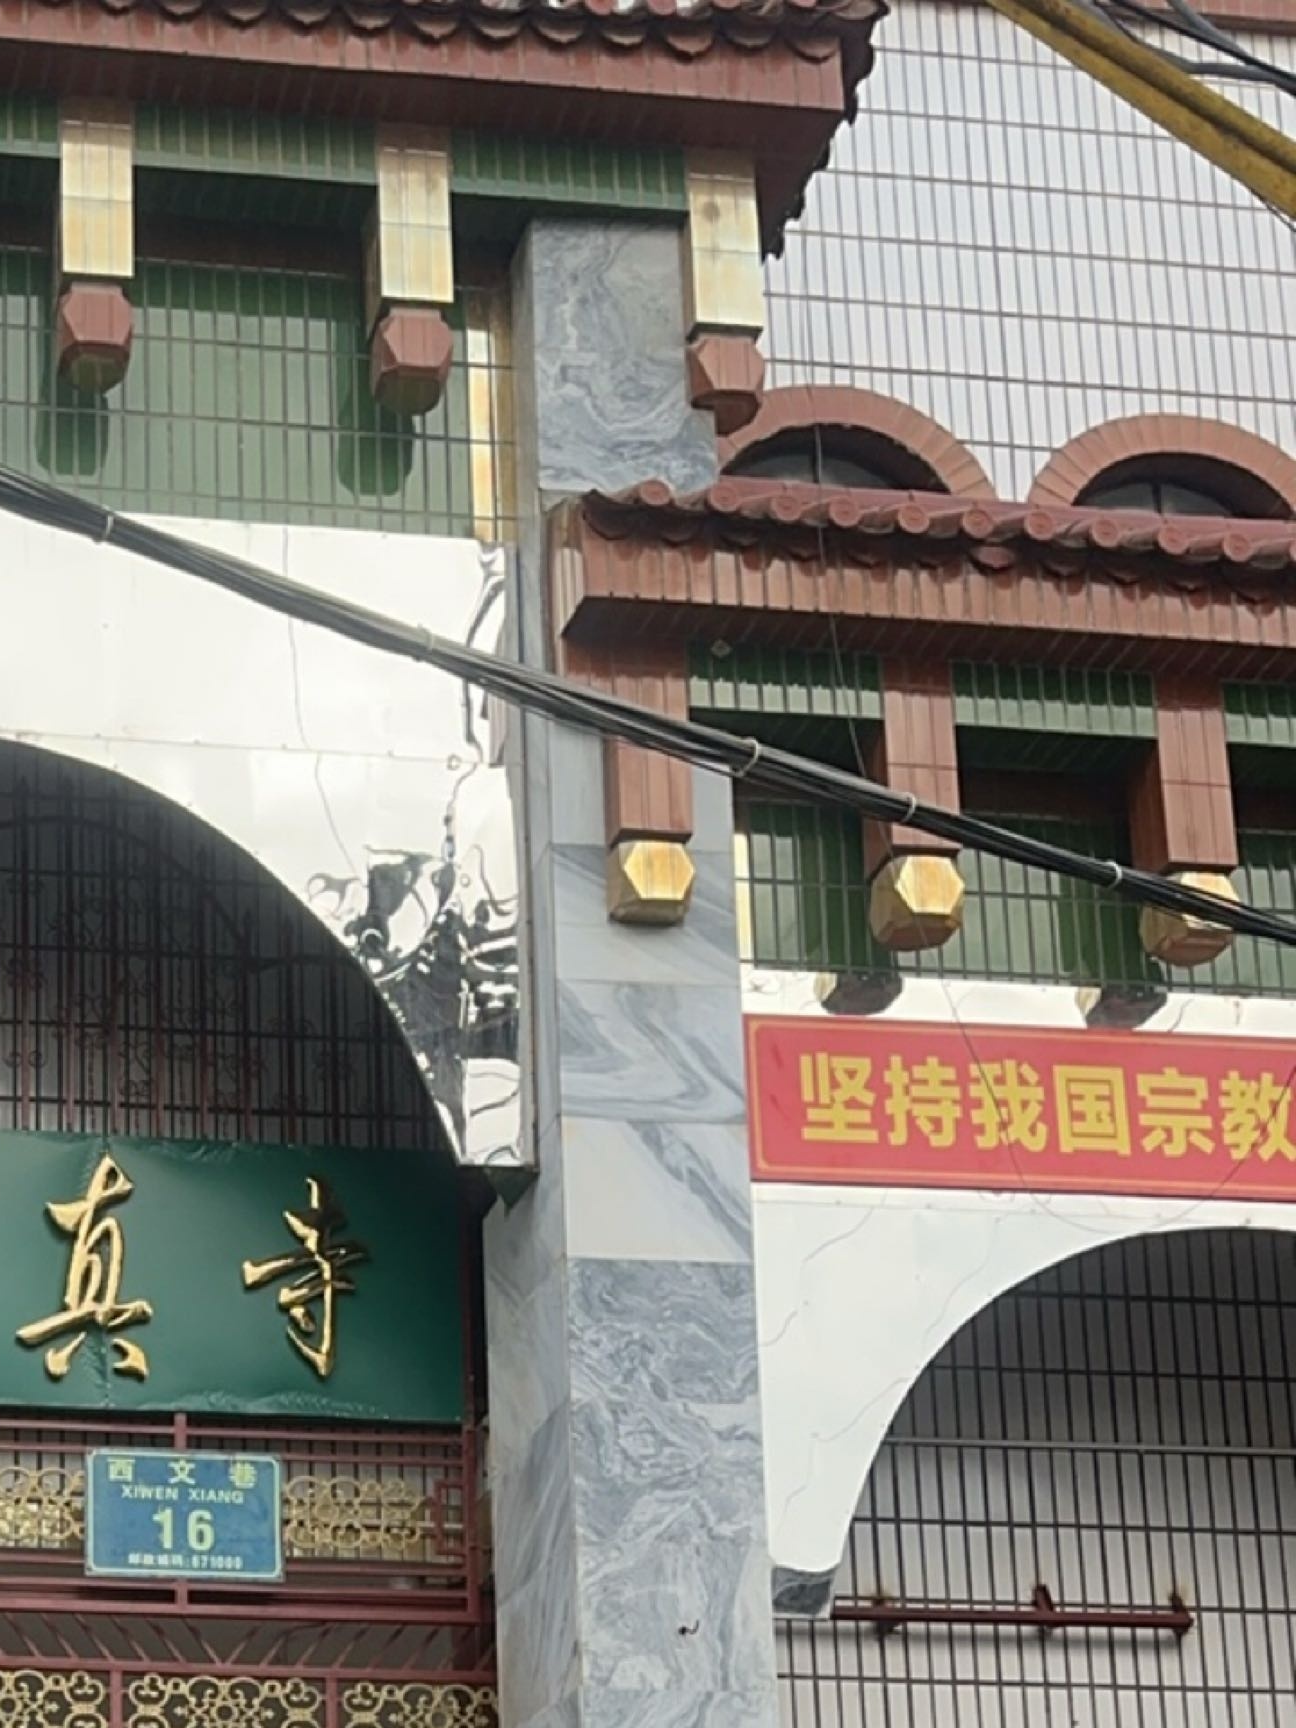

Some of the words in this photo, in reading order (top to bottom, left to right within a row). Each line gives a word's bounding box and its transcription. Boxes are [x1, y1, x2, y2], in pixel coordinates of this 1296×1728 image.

[800, 1051, 1296, 1162] 坚持我国宗教
[107, 1456, 258, 1489] 西文巷
[121, 1484, 179, 1501] XIWEN
[188, 1488, 244, 1504] XIANG
[152, 1507, 215, 1552] 16
